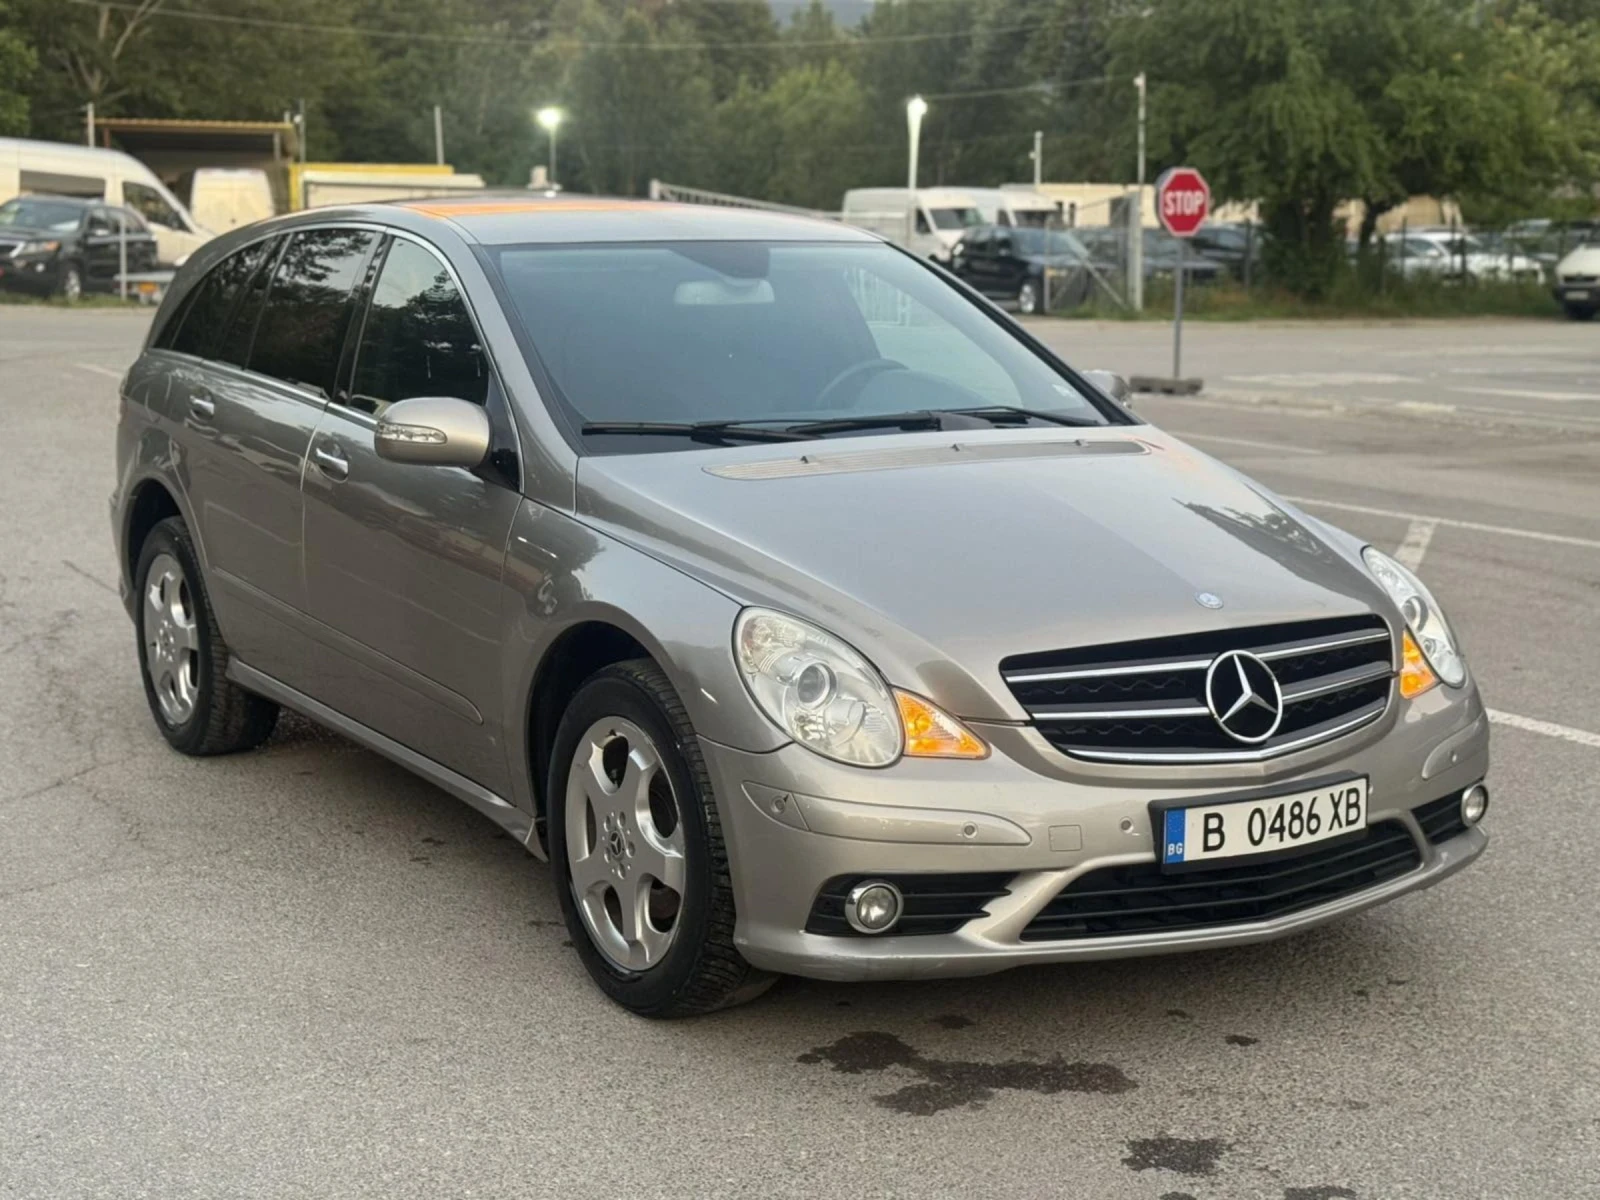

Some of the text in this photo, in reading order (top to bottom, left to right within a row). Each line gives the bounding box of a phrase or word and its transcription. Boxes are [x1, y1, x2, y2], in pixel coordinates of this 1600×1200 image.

[1165, 190, 1204, 215] STOP
[1203, 788, 1361, 852] B 0486 XB
[1167, 842, 1183, 856] BG
